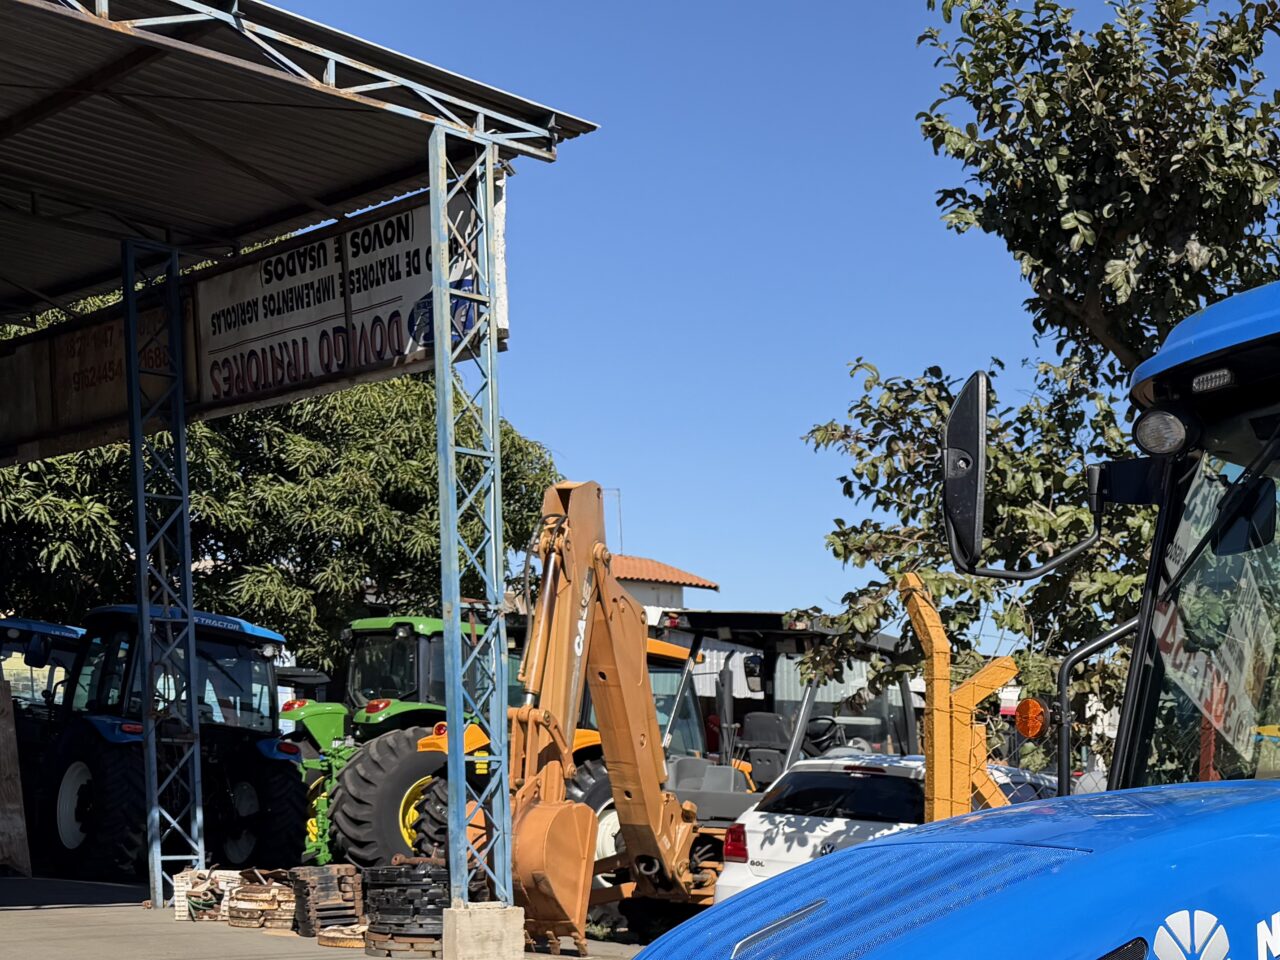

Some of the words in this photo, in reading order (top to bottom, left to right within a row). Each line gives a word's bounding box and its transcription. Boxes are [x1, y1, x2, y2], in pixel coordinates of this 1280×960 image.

[350, 211, 415, 257] (NOVOS
[257, 241, 329, 289] USADOS)
[348, 254, 402, 296] TRATORES
[405, 247, 421, 278] DE
[210, 294, 259, 336] AGRÍCOLAS
[261, 273, 336, 319] IMPLEMENTOS
[318, 311, 404, 372] DOVIGO
[208, 337, 313, 401] TRATORES
[200, 618, 240, 631] TRACTOR
[749, 859, 766, 867] GOL
